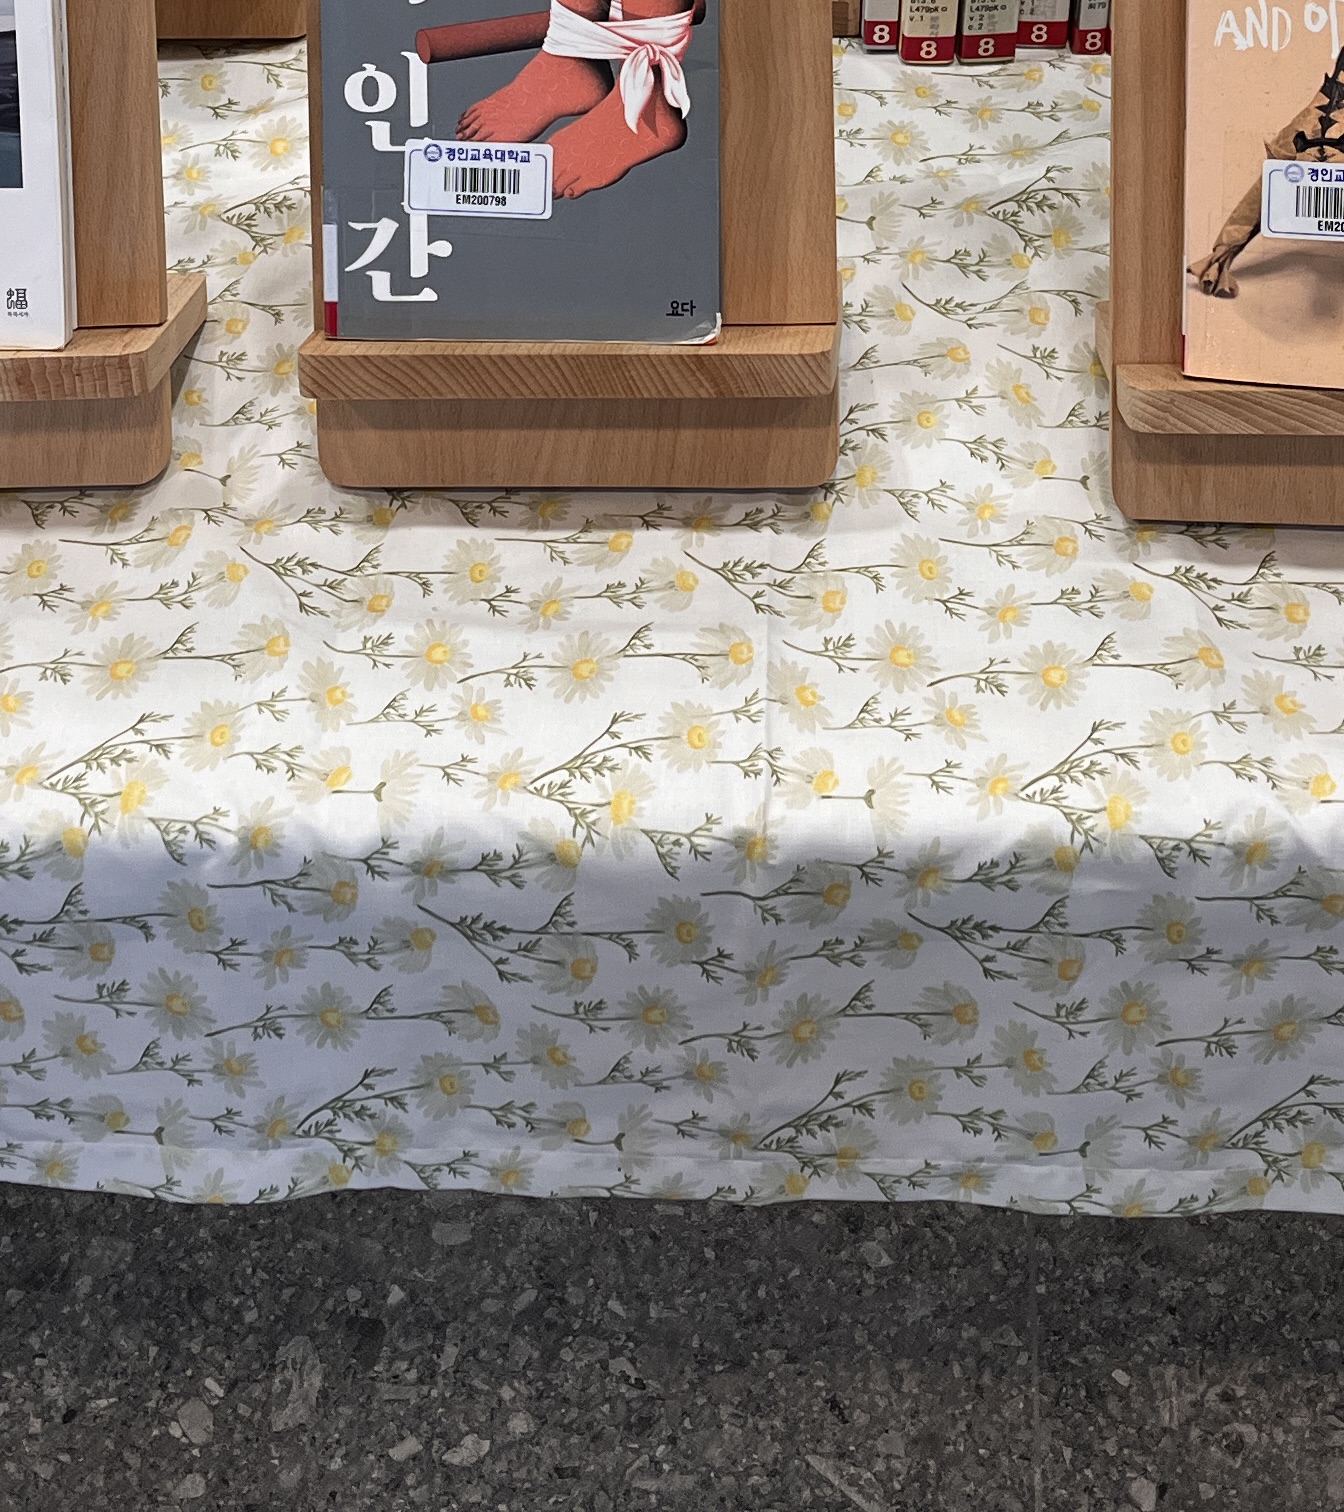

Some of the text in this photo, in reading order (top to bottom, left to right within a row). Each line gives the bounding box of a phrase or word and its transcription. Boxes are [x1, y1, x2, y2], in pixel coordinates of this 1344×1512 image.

[872, 24, 890, 44] 8
[1030, 23, 1048, 43] 8
[1085, 31, 1102, 51] 8
[919, 40, 938, 60] 8
[977, 38, 995, 57] 8
[443, 147, 532, 165] 경인교육대학교
[454, 194, 507, 207] EM200798
[665, 299, 697, 317] 요다
